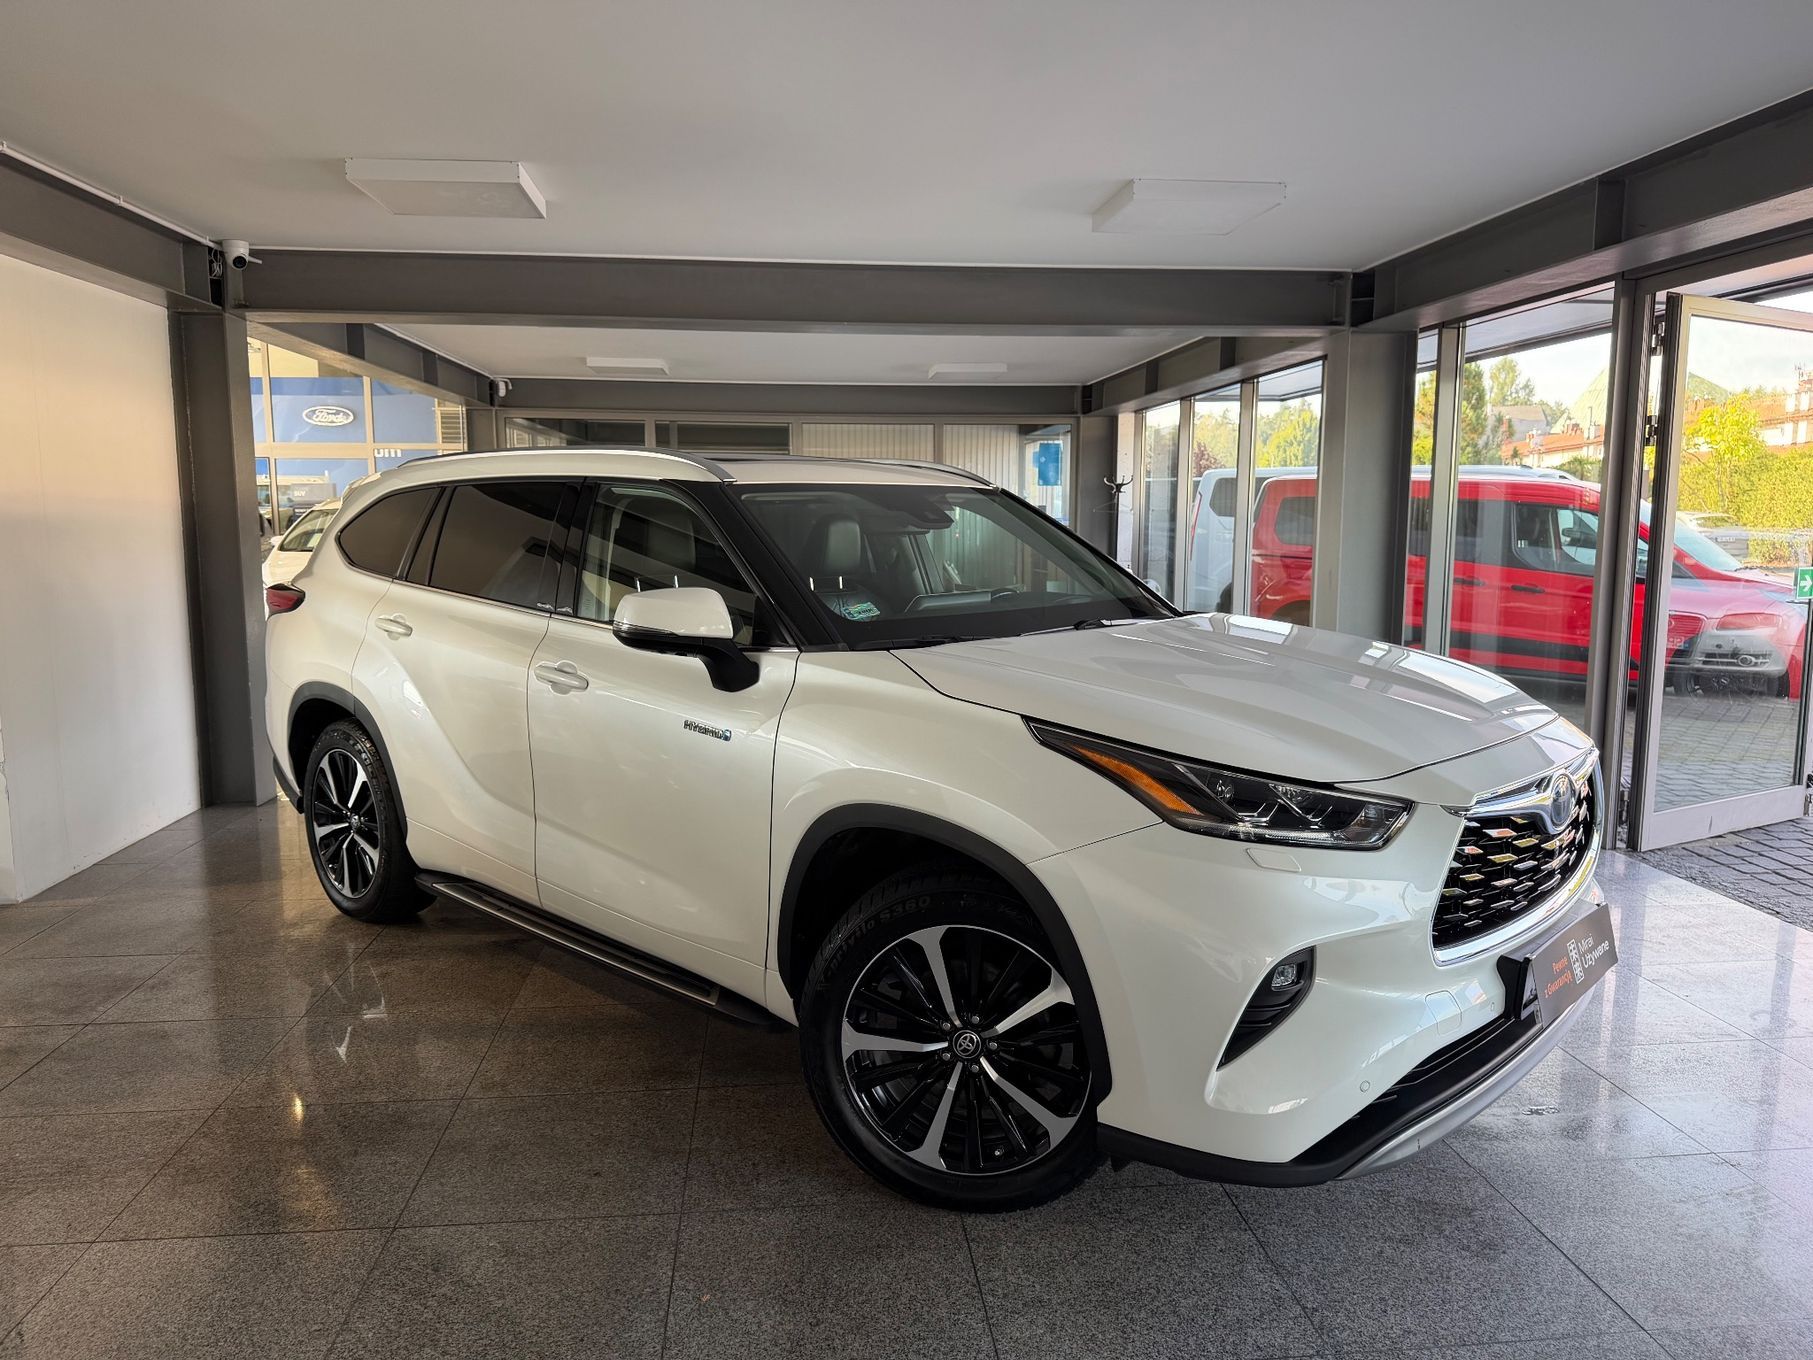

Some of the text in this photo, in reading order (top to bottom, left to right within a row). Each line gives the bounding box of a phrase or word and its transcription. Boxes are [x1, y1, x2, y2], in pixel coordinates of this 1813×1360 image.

[311, 406, 350, 424] Ford
[879, 895, 932, 920] S360
[1577, 933, 1595, 954] Mirai
[1581, 940, 1610, 968] Używane
[1552, 956, 1568, 974] Pewne
